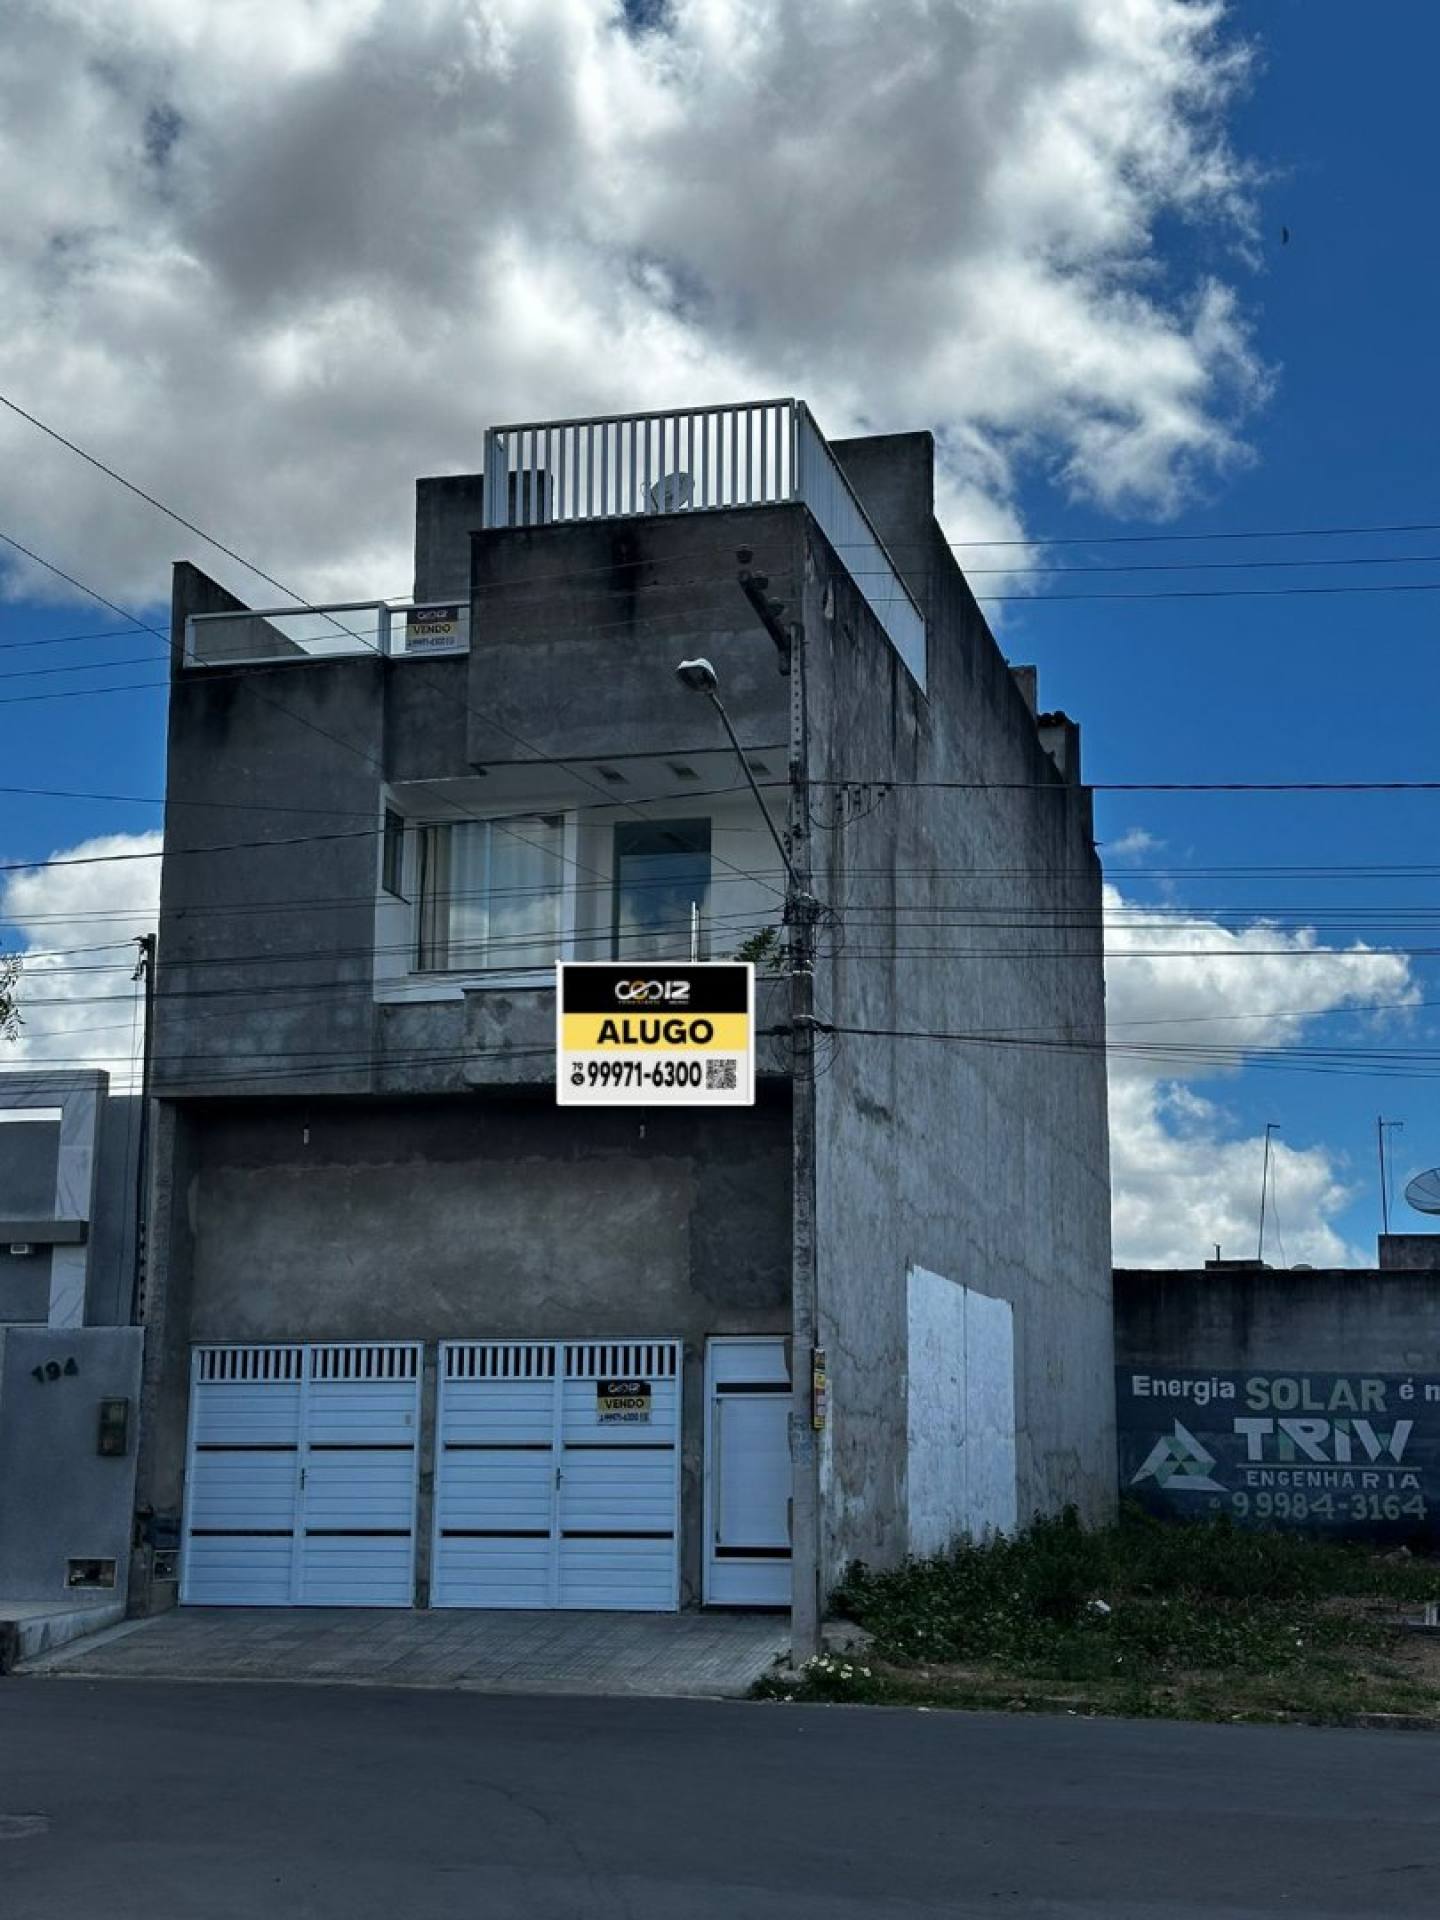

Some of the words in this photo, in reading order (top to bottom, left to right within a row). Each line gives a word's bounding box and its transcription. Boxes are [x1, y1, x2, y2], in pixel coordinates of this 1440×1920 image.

[605, 1398, 645, 1409] VENDO
[1131, 1375, 1236, 1405] Energia
[1246, 1376, 1388, 1413] SOLAR
[1399, 1377, 1415, 1400] é
[1247, 1469, 1421, 1490] ENGENHARIA
[1256, 1492, 1428, 1521] 9984-3164
